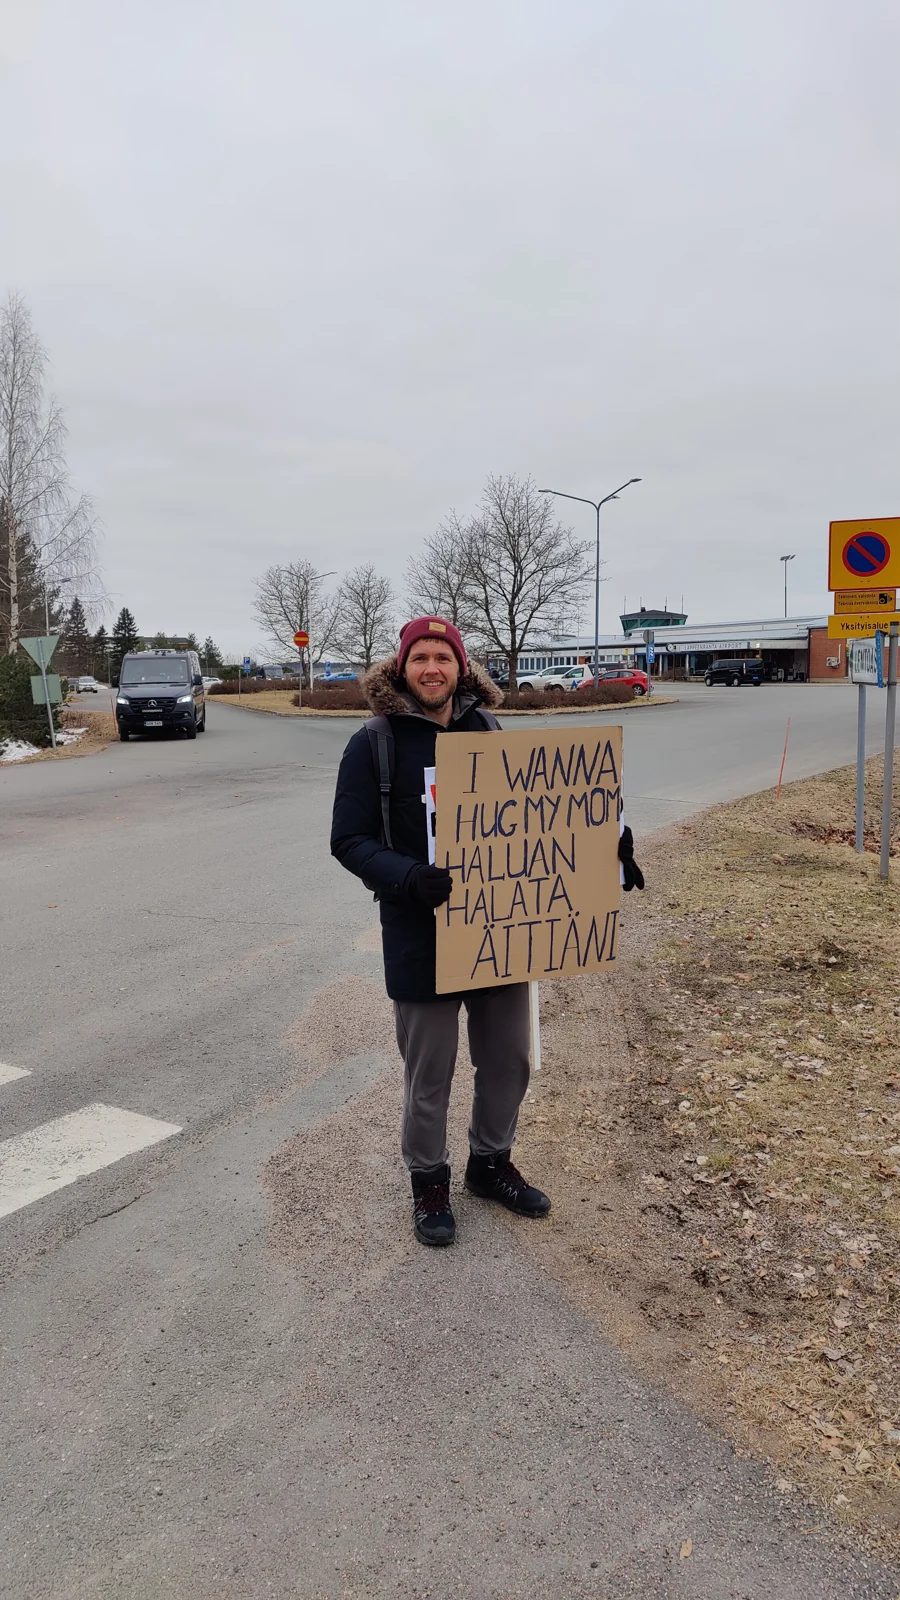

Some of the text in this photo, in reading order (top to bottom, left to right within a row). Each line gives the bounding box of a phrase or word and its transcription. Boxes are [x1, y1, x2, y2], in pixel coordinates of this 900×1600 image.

[840, 622, 889, 631] Yksityisalue
[463, 740, 618, 794] I WANNA
[456, 785, 621, 844] HUG MY MOM
[446, 833, 575, 885] HALUAN
[446, 874, 573, 927] HALATA
[470, 910, 619, 980] ÄITIÄNI
